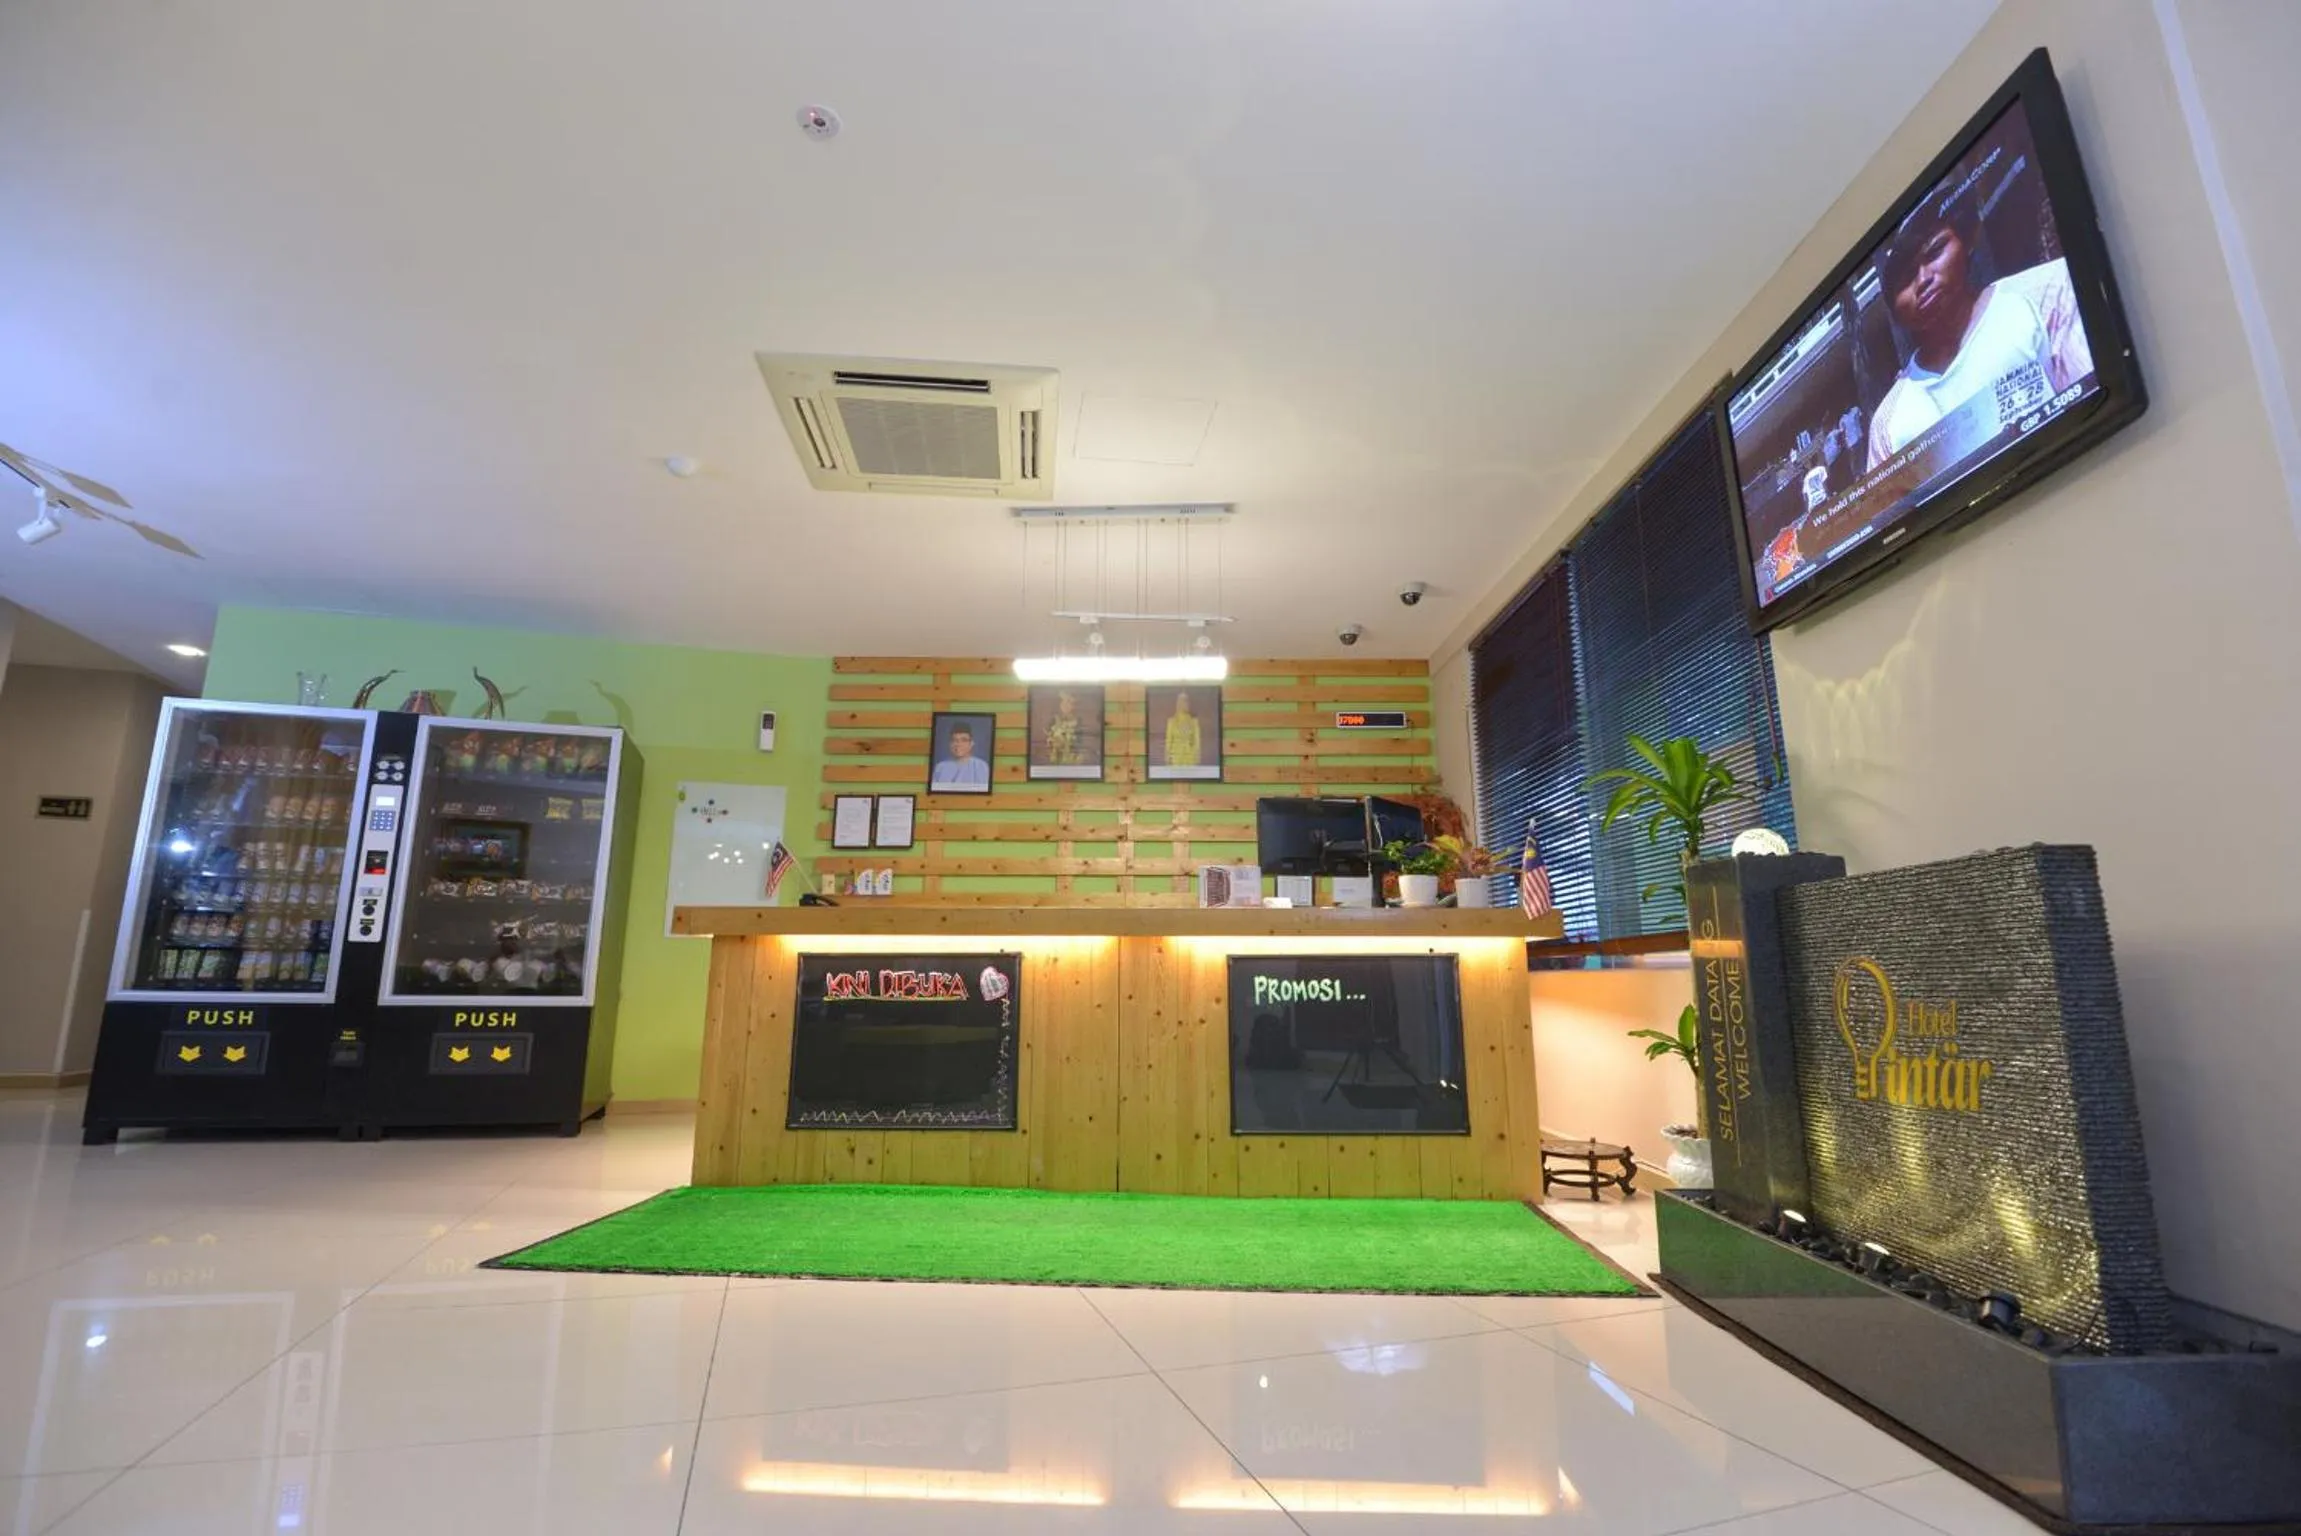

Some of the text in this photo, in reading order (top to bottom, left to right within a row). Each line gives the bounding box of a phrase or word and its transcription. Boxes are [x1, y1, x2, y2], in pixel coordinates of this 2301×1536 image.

[1812, 515, 1828, 528] We
[1828, 497, 1848, 517] hold
[1850, 486, 1866, 502] this
[1867, 457, 1907, 488] national
[187, 1010, 255, 1026] PUSH
[453, 1011, 518, 1027] PUSH
[1702, 919, 1734, 1142] SELAMAT DATAG
[1726, 960, 1751, 1100] WELCOME
[1907, 999, 1957, 1036] Hotel
